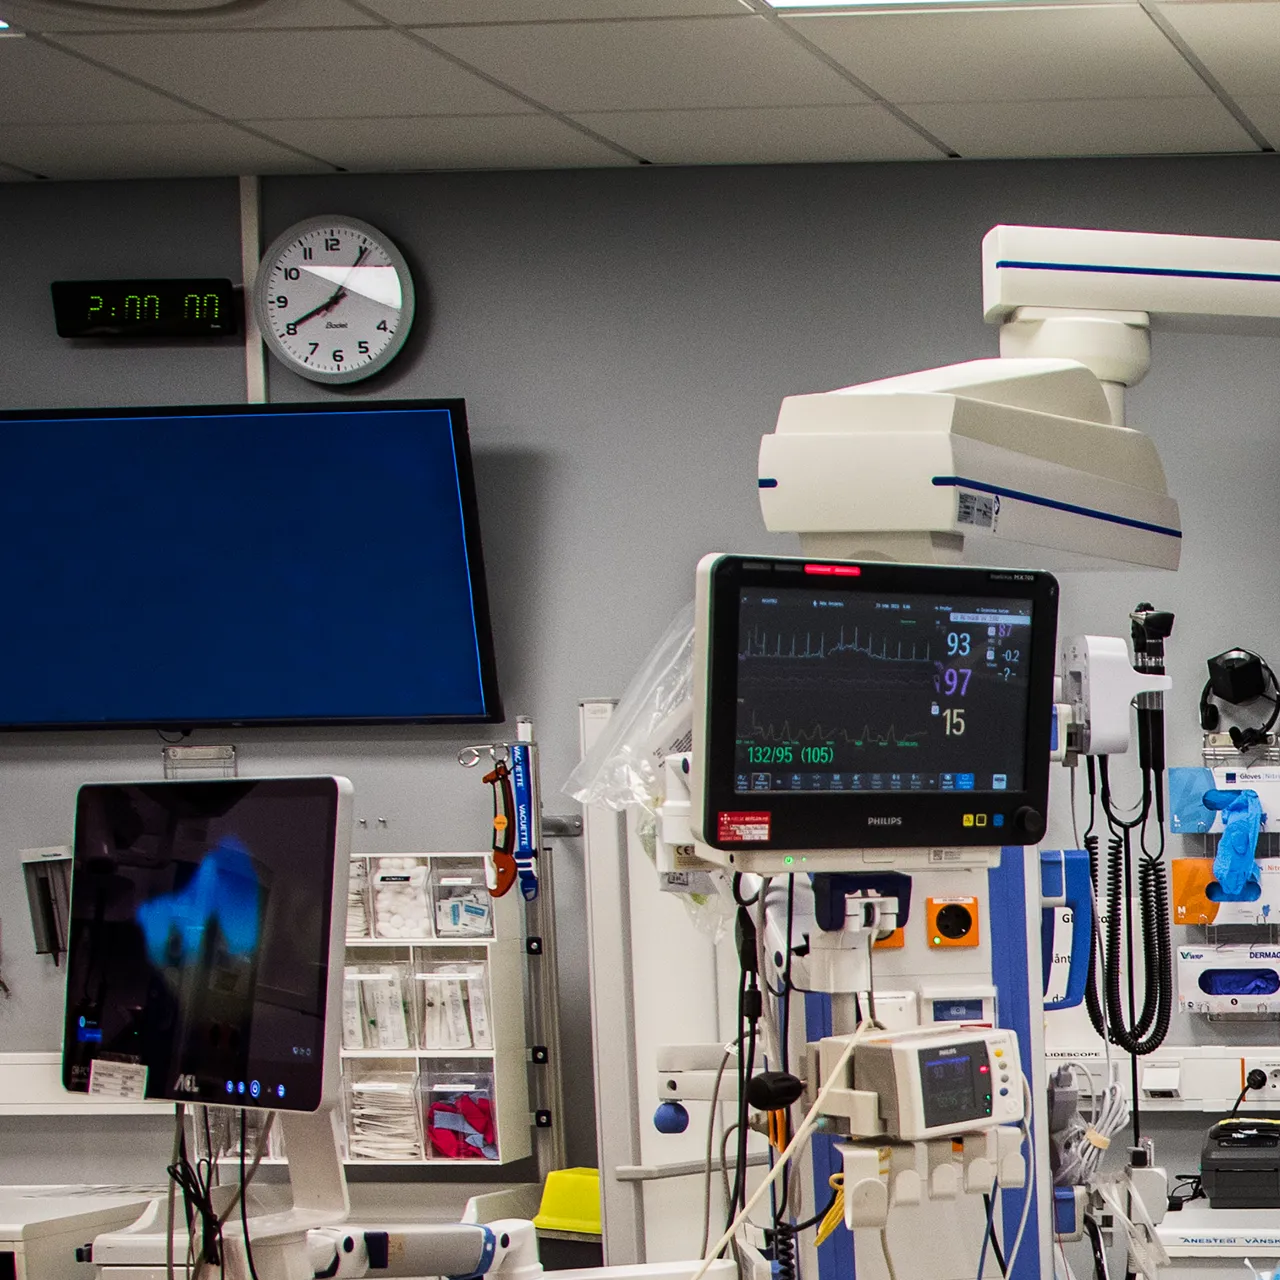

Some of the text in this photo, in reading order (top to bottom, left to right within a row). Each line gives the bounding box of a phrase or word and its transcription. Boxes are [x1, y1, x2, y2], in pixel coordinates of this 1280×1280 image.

[325, 239, 340, 251] 12
[303, 247, 313, 260] 11
[284, 268, 300, 281] 10
[276, 296, 288, 308] 9
[287, 323, 297, 335] 8
[377, 320, 388, 331] 4
[309, 343, 319, 355] 7
[358, 341, 369, 353] 5
[333, 350, 343, 362] 6
[998, 624, 1012, 637] 87
[947, 632, 971, 656] 93
[944, 668, 972, 696] 97
[942, 708, 966, 736] 15
[747, 746, 834, 764] 132/95 (105)
[868, 816, 902, 825] PHILIPS
[1174, 814, 1180, 822] L
[519, 804, 528, 846] VACUETTE
[1178, 906, 1186, 914] M
[939, 1048, 957, 1056] PHILIPS
